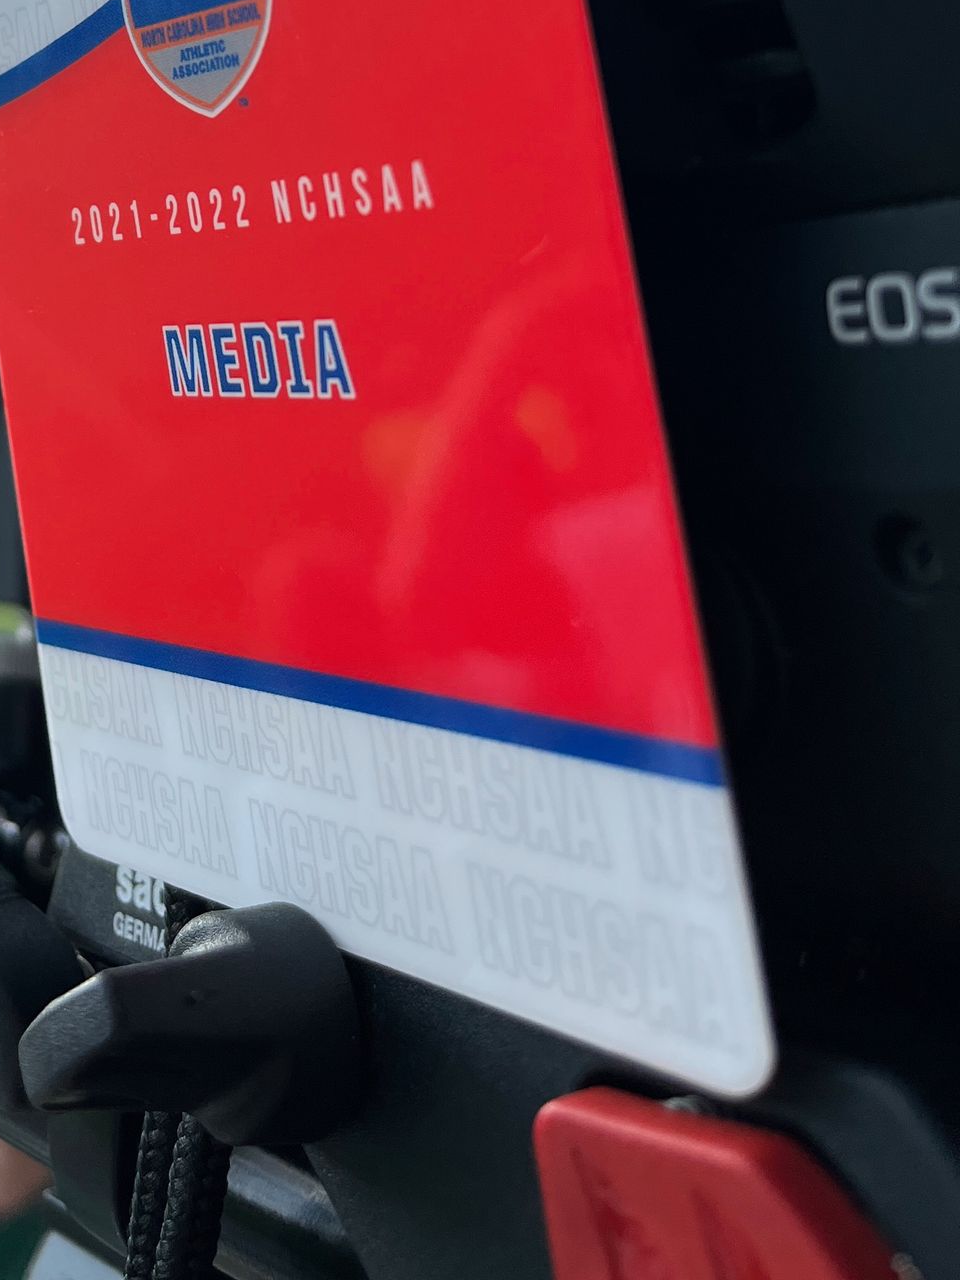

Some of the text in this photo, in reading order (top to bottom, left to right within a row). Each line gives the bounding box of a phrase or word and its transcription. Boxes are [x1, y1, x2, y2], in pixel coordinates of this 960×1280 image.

[172, 54, 240, 81] ASSOCIATION
[180, 40, 226, 62] ATHLETIC
[71, 159, 435, 246] 2021-2022 NCHSAA
[826, 267, 960, 343] EOS
[162, 318, 356, 399] MEDIA
[172, 675, 357, 801] NCHSAA
[366, 720, 614, 871] NCHSAA
[80, 750, 239, 881] NCHSAA
[247, 797, 456, 957] NCHSAA
